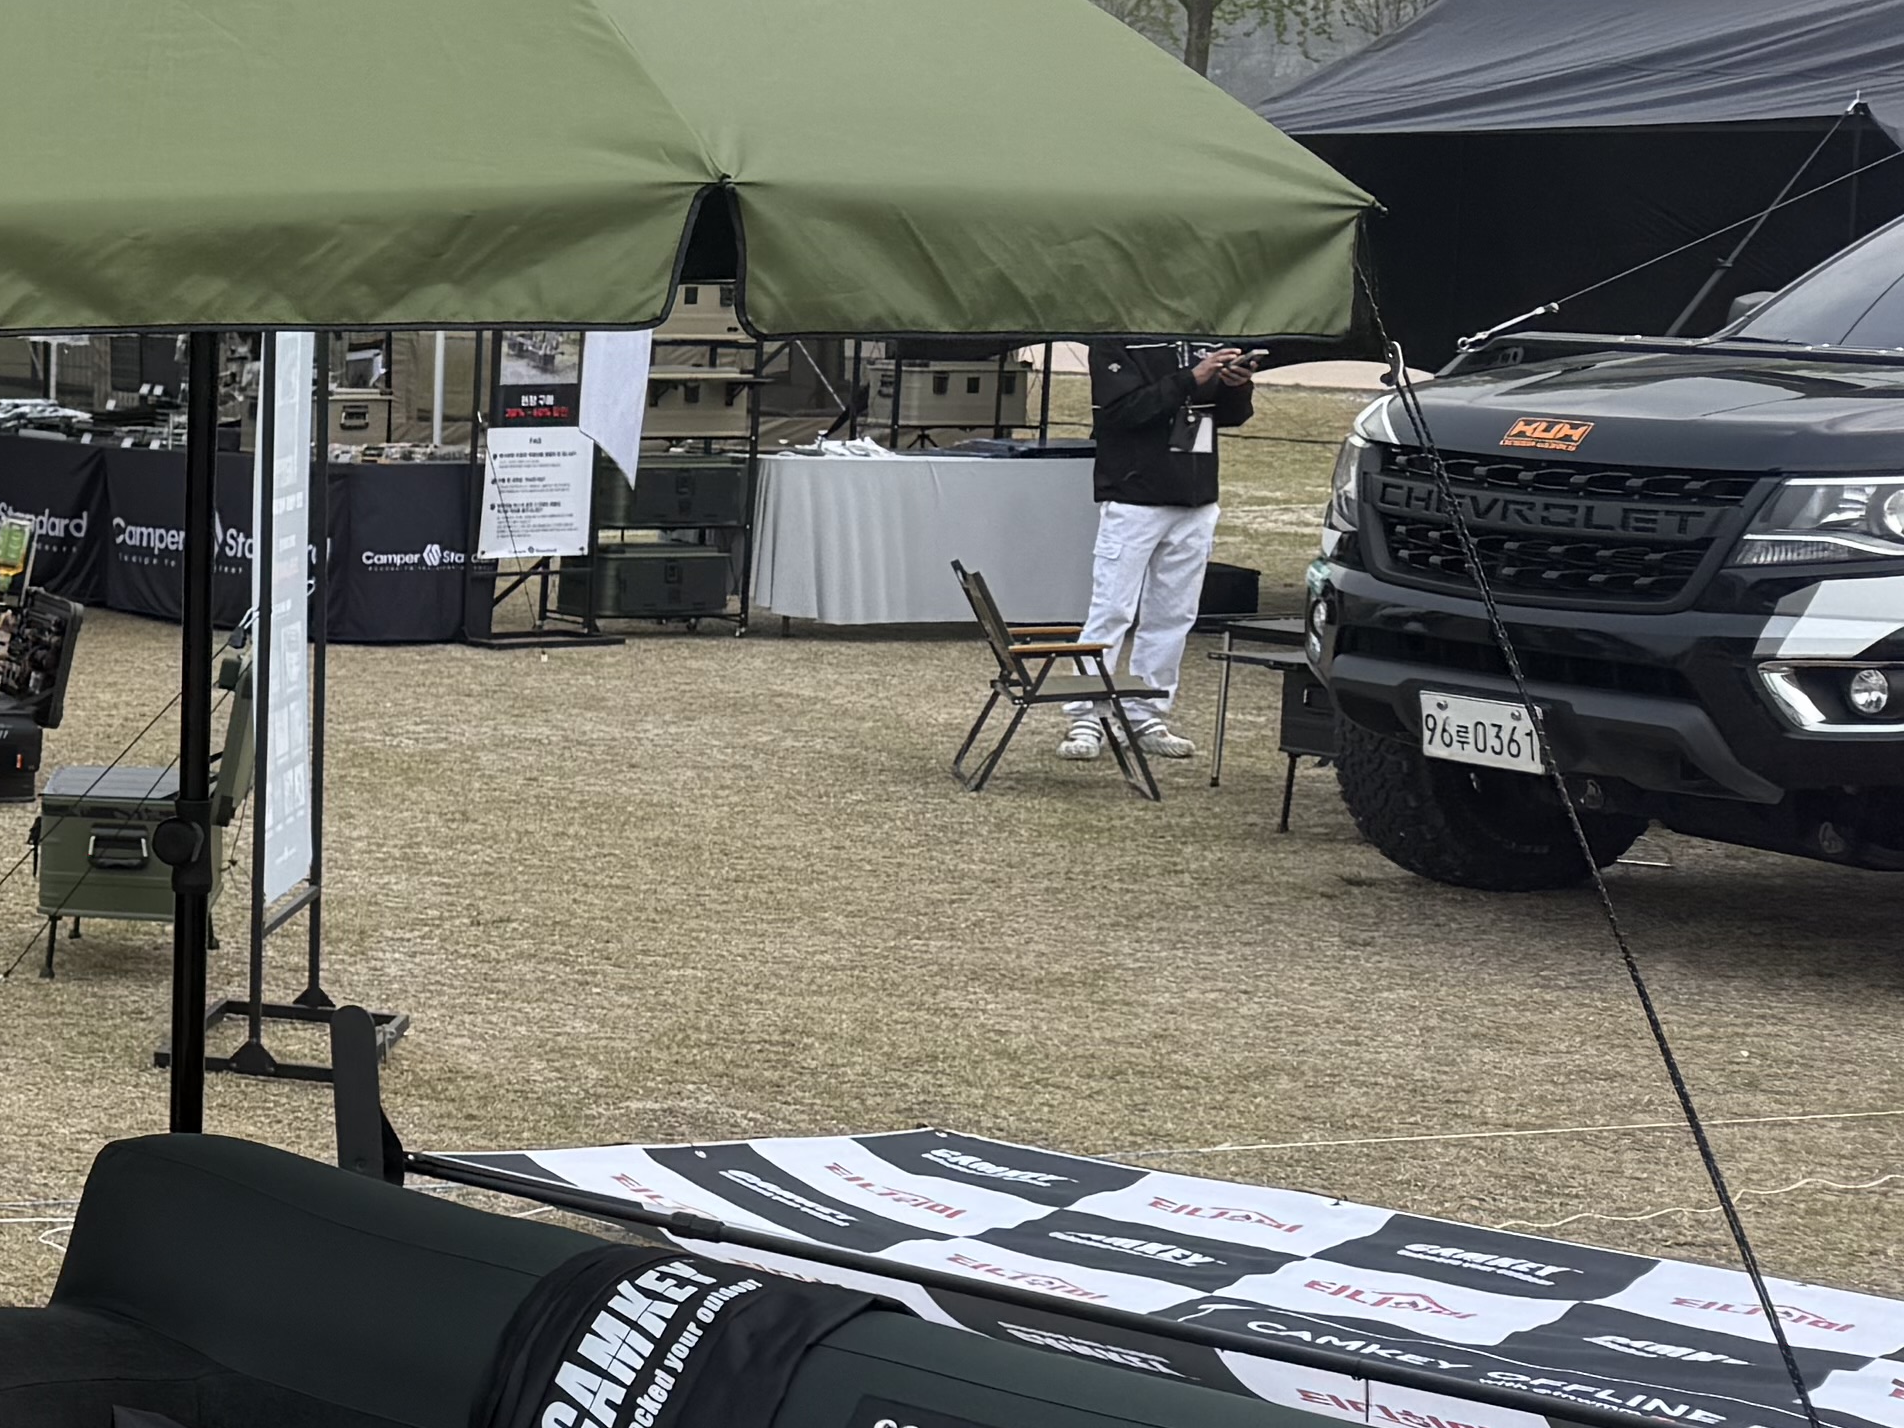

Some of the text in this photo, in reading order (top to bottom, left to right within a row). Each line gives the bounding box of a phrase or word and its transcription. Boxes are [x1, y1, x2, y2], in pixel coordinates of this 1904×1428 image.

[362, 551, 420, 567] Camper
[664, 1321, 703, 1373] your
[1247, 1320, 1472, 1370] CAMKEY
[1487, 1371, 1728, 1425] OFFLINE
